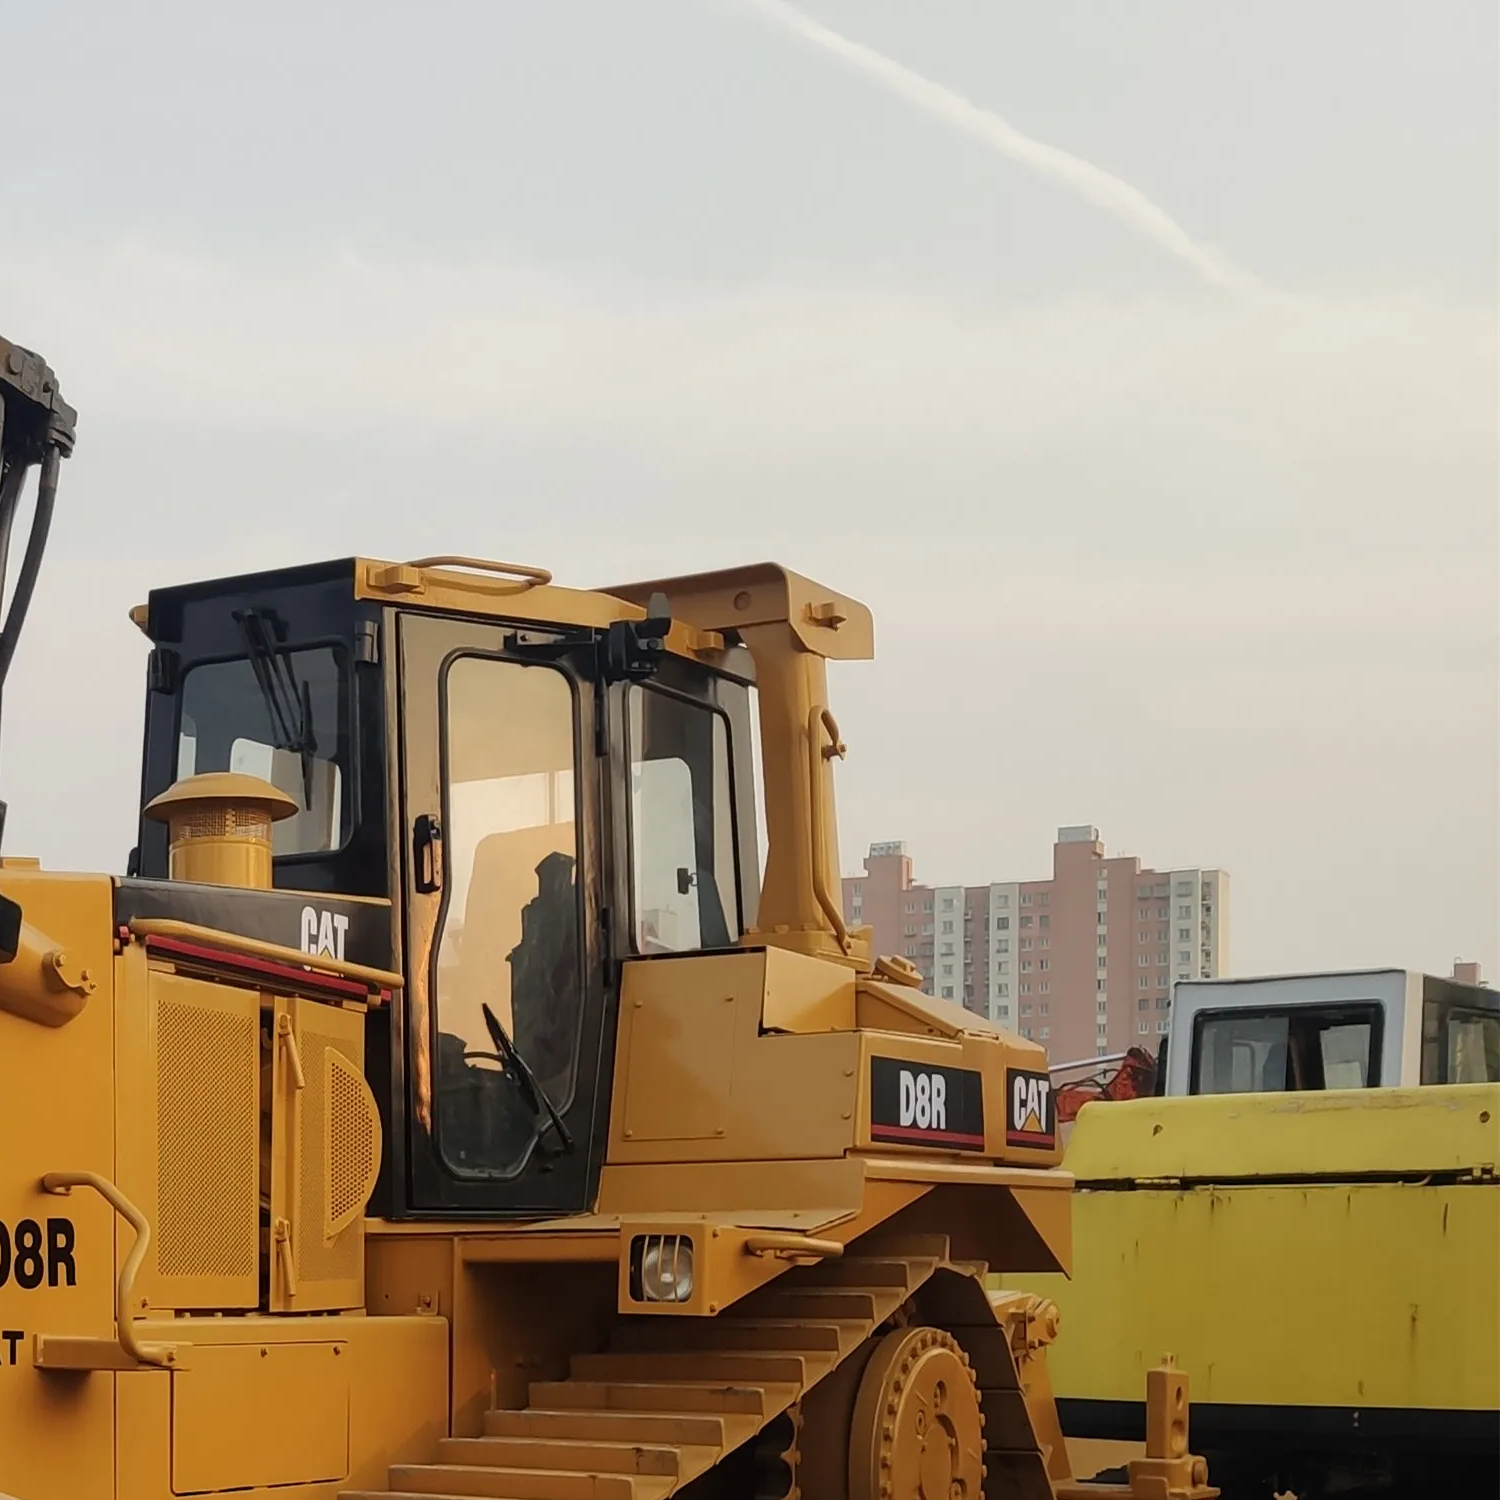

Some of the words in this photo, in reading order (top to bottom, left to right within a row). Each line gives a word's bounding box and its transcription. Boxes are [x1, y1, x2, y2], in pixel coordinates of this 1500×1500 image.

[300, 905, 349, 977] CAT
[899, 1069, 946, 1129] D8R
[1013, 1075, 1049, 1134] CAT
